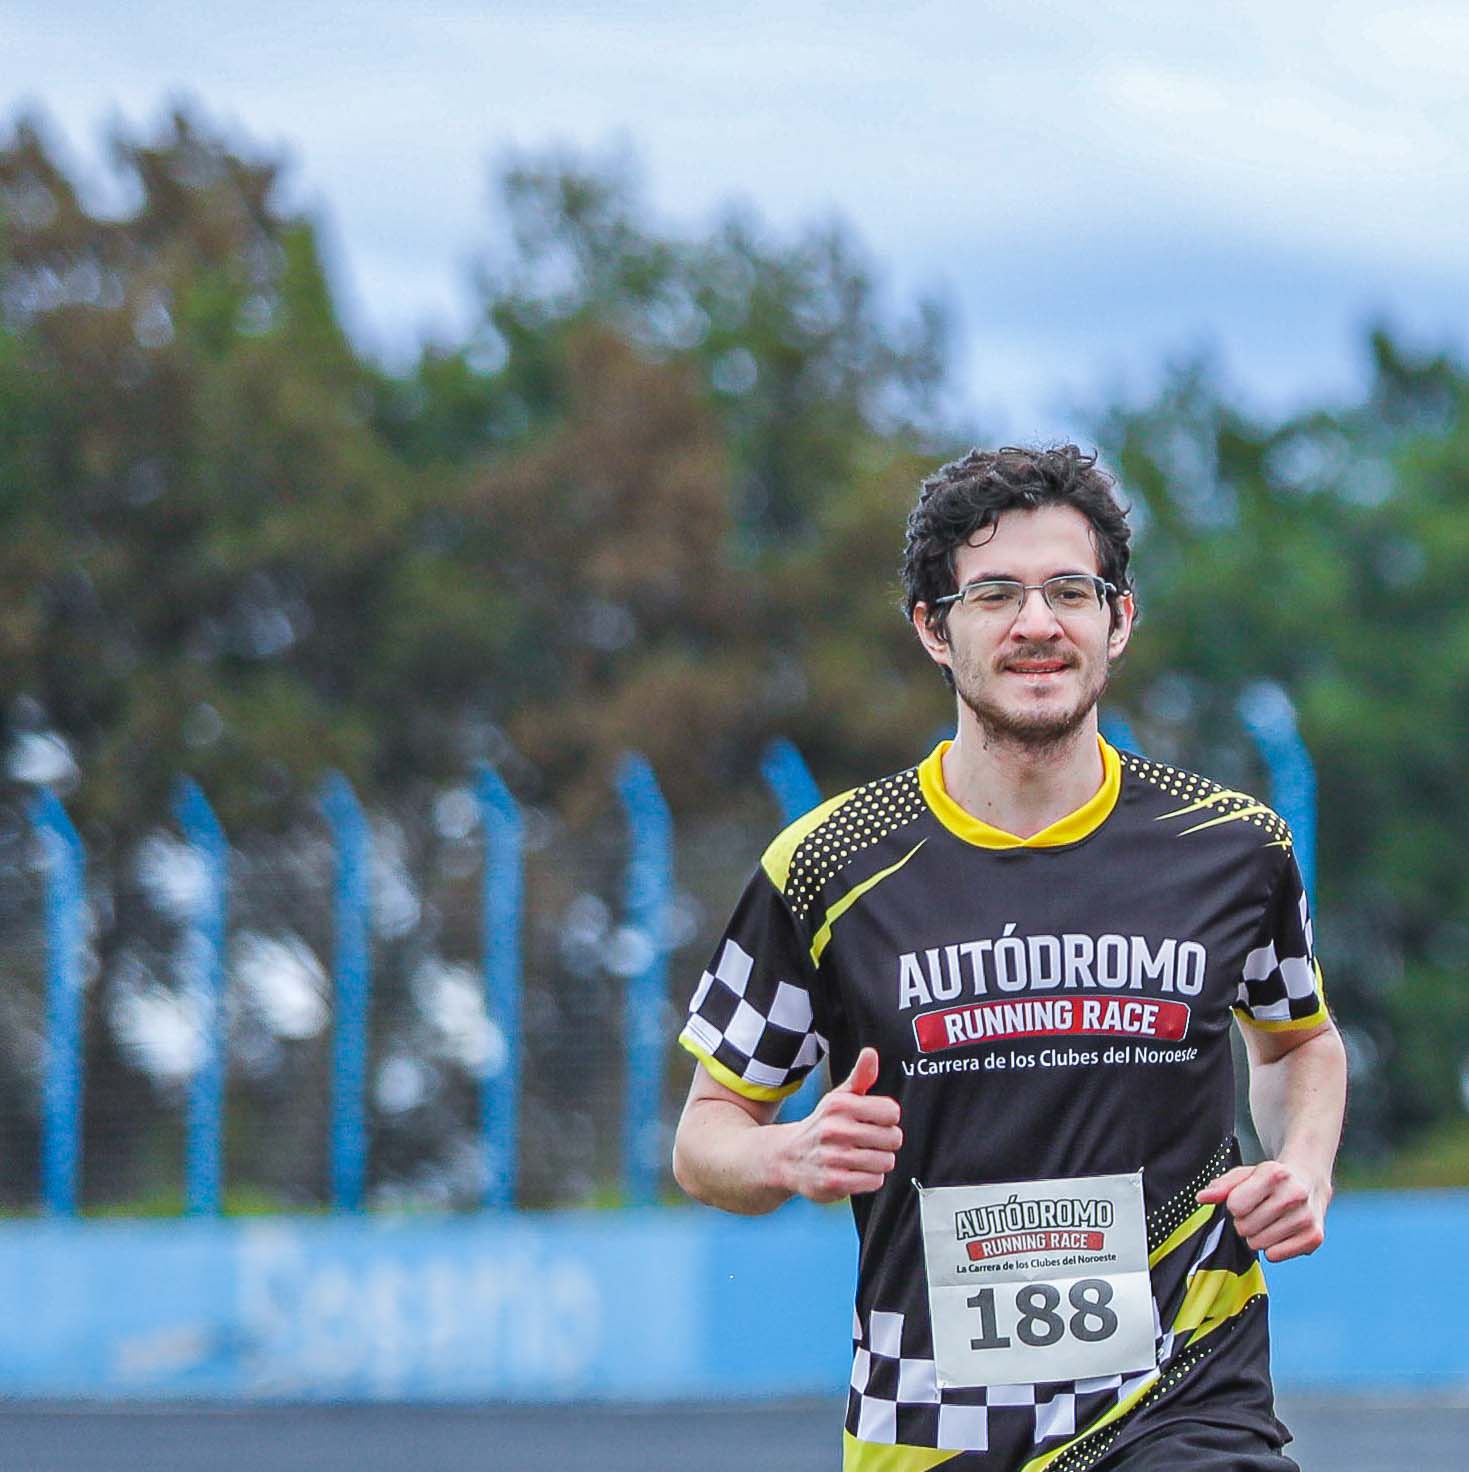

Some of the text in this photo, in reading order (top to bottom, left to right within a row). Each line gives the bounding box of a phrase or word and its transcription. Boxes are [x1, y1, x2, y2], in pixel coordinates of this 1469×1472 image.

[898, 922, 1208, 1010] AUTÓDROMO
[944, 999, 1160, 1047] RUNNING RACE
[917, 1057, 980, 1076] Carrera
[984, 1051, 1007, 1070] de
[1010, 1050, 1037, 1069] los
[1039, 1048, 1100, 1067] Clubes
[1103, 1046, 1130, 1064] del
[1134, 1046, 1198, 1064] Noroeste
[955, 1194, 1114, 1241] AUTÓDROMO
[956, 1253, 1117, 1274] La Carrera de los Clubes del Noroeste
[981, 1231, 1089, 1258] RUNNING RACE
[966, 1278, 1118, 1351] 188
